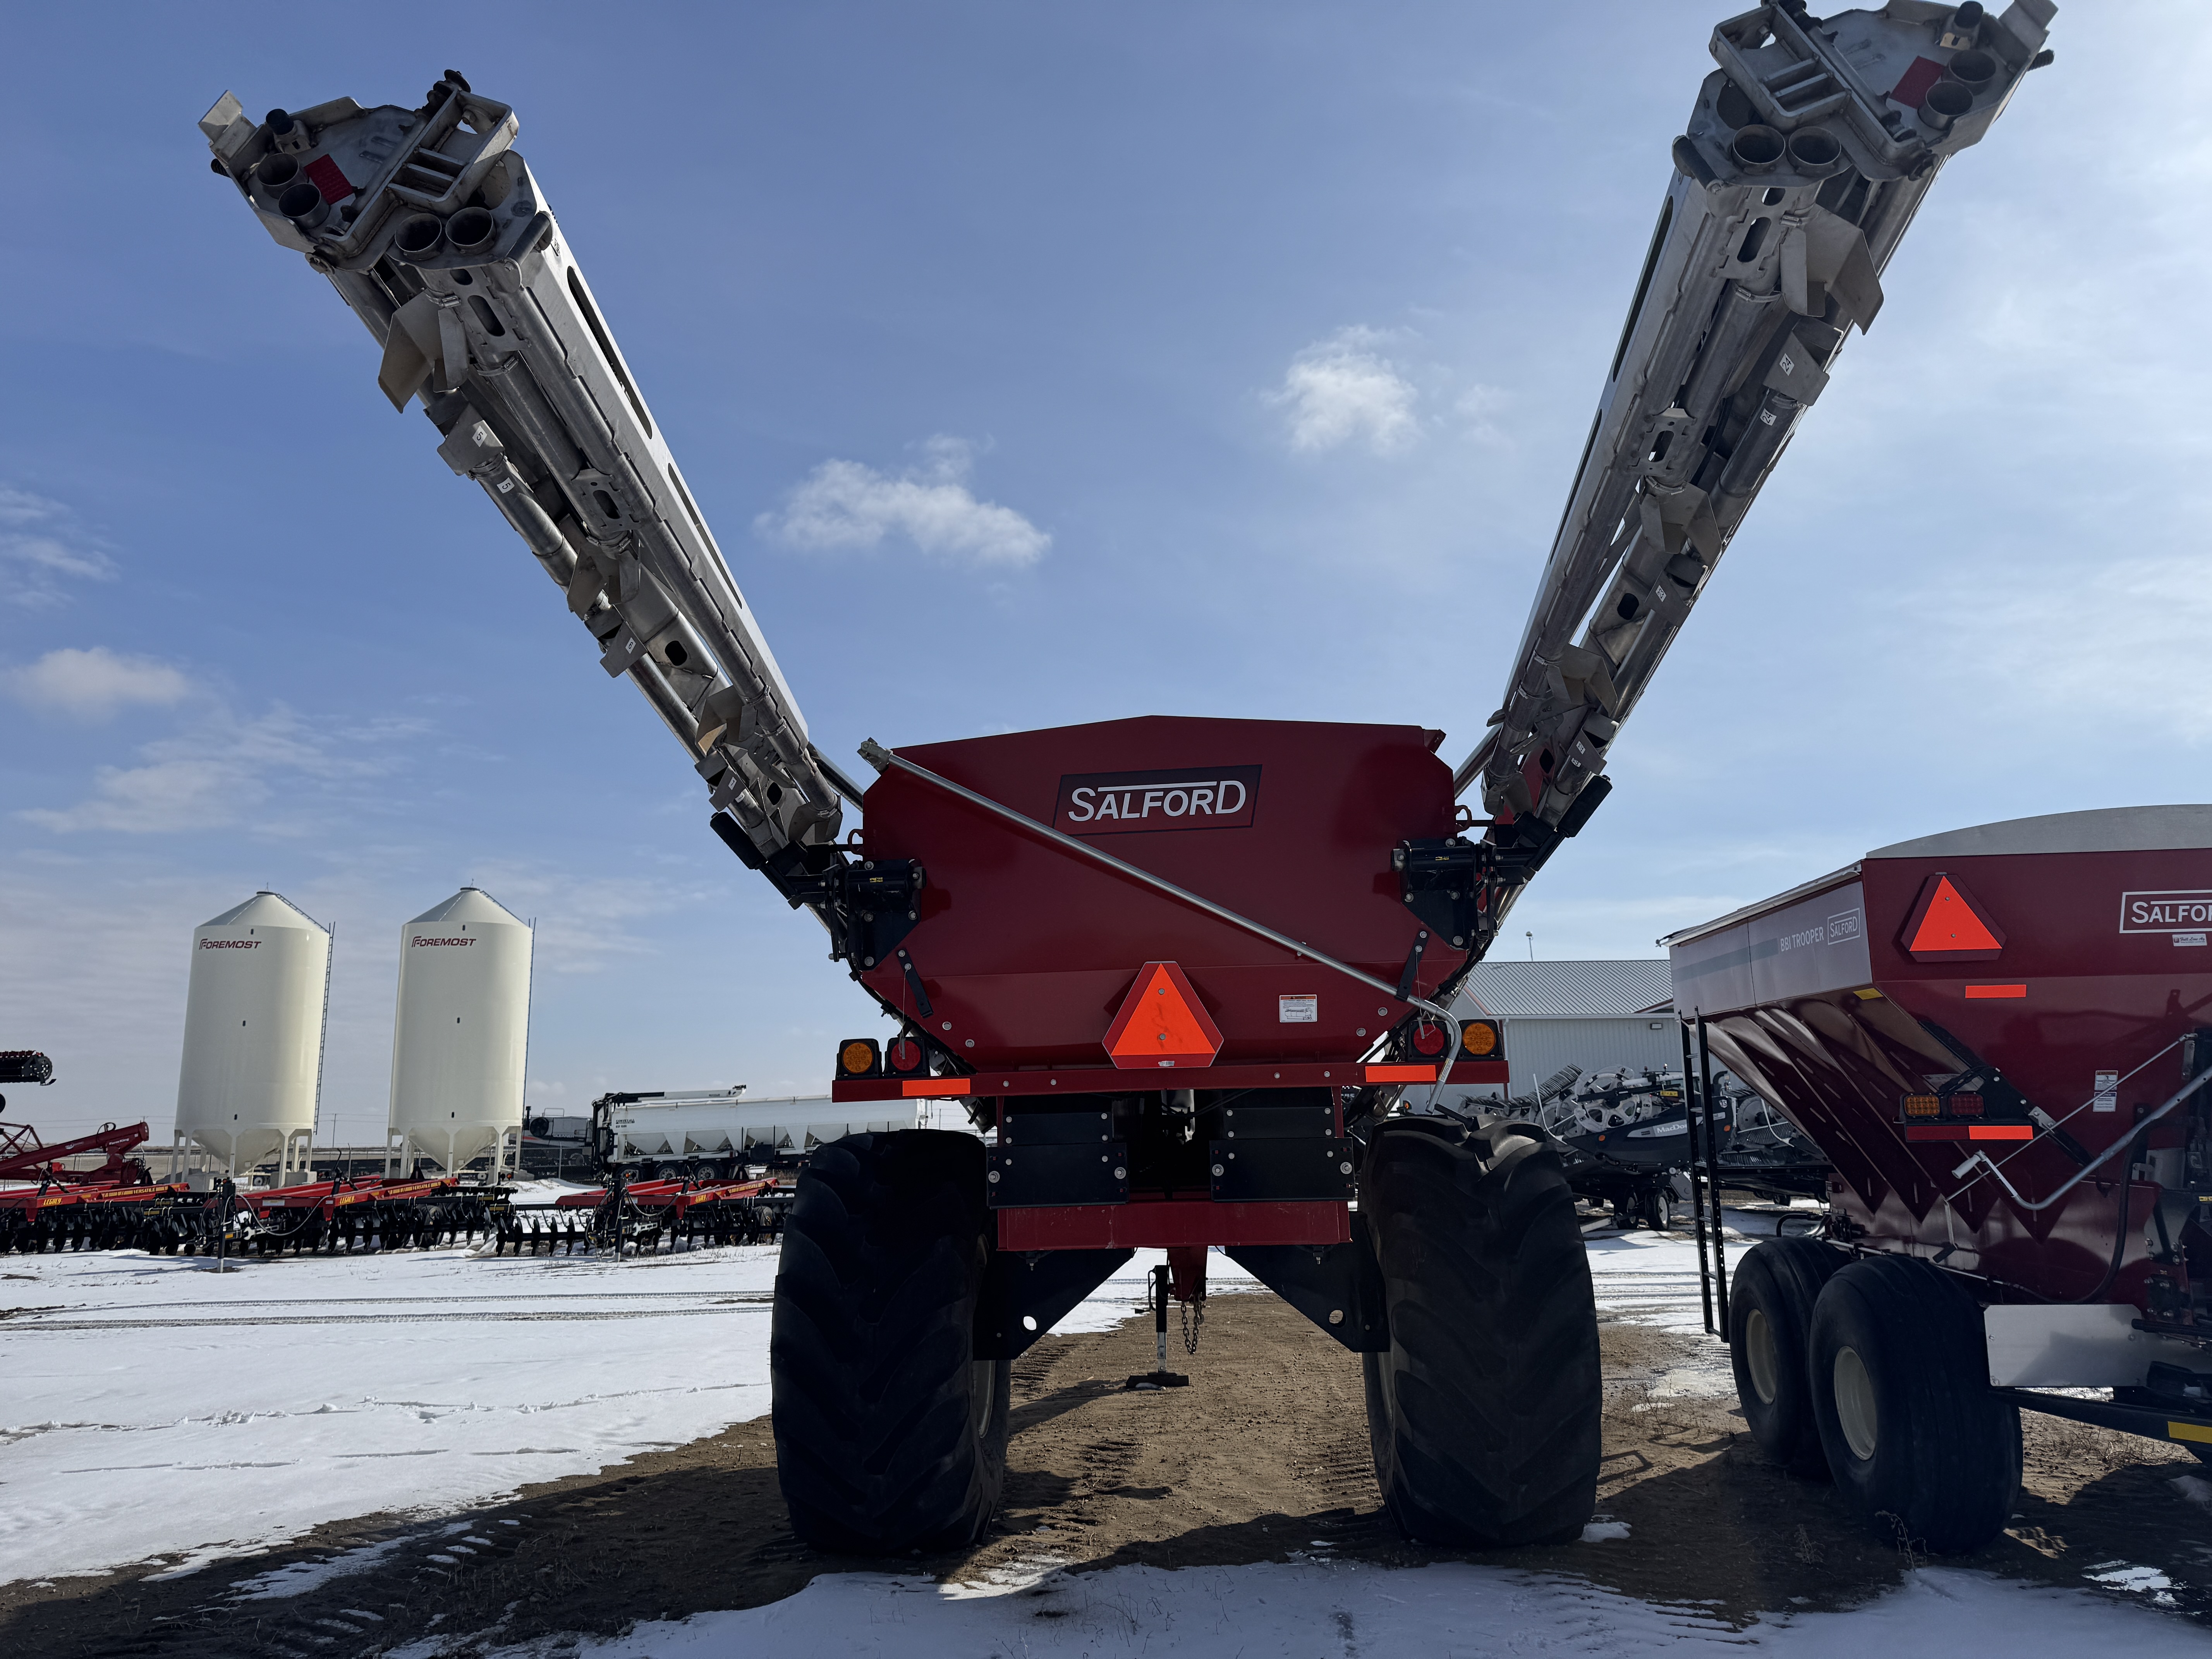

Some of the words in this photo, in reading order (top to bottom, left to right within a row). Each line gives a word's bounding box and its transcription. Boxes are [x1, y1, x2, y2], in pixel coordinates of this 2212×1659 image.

[1782, 357, 1791, 372] 24
[1762, 412, 1772, 423] 24
[477, 432, 483, 441] 5
[1657, 588, 1664, 599] 23
[1068, 780, 1246, 822] SALFORD
[2131, 900, 2212, 924] SALFO
[1830, 916, 1858, 938] SALFORD
[199, 938, 261, 950] FOREMOST
[412, 936, 476, 948] FOREMOST
[1780, 936, 1791, 952] BBI
[1792, 926, 1824, 948] TROOPER
